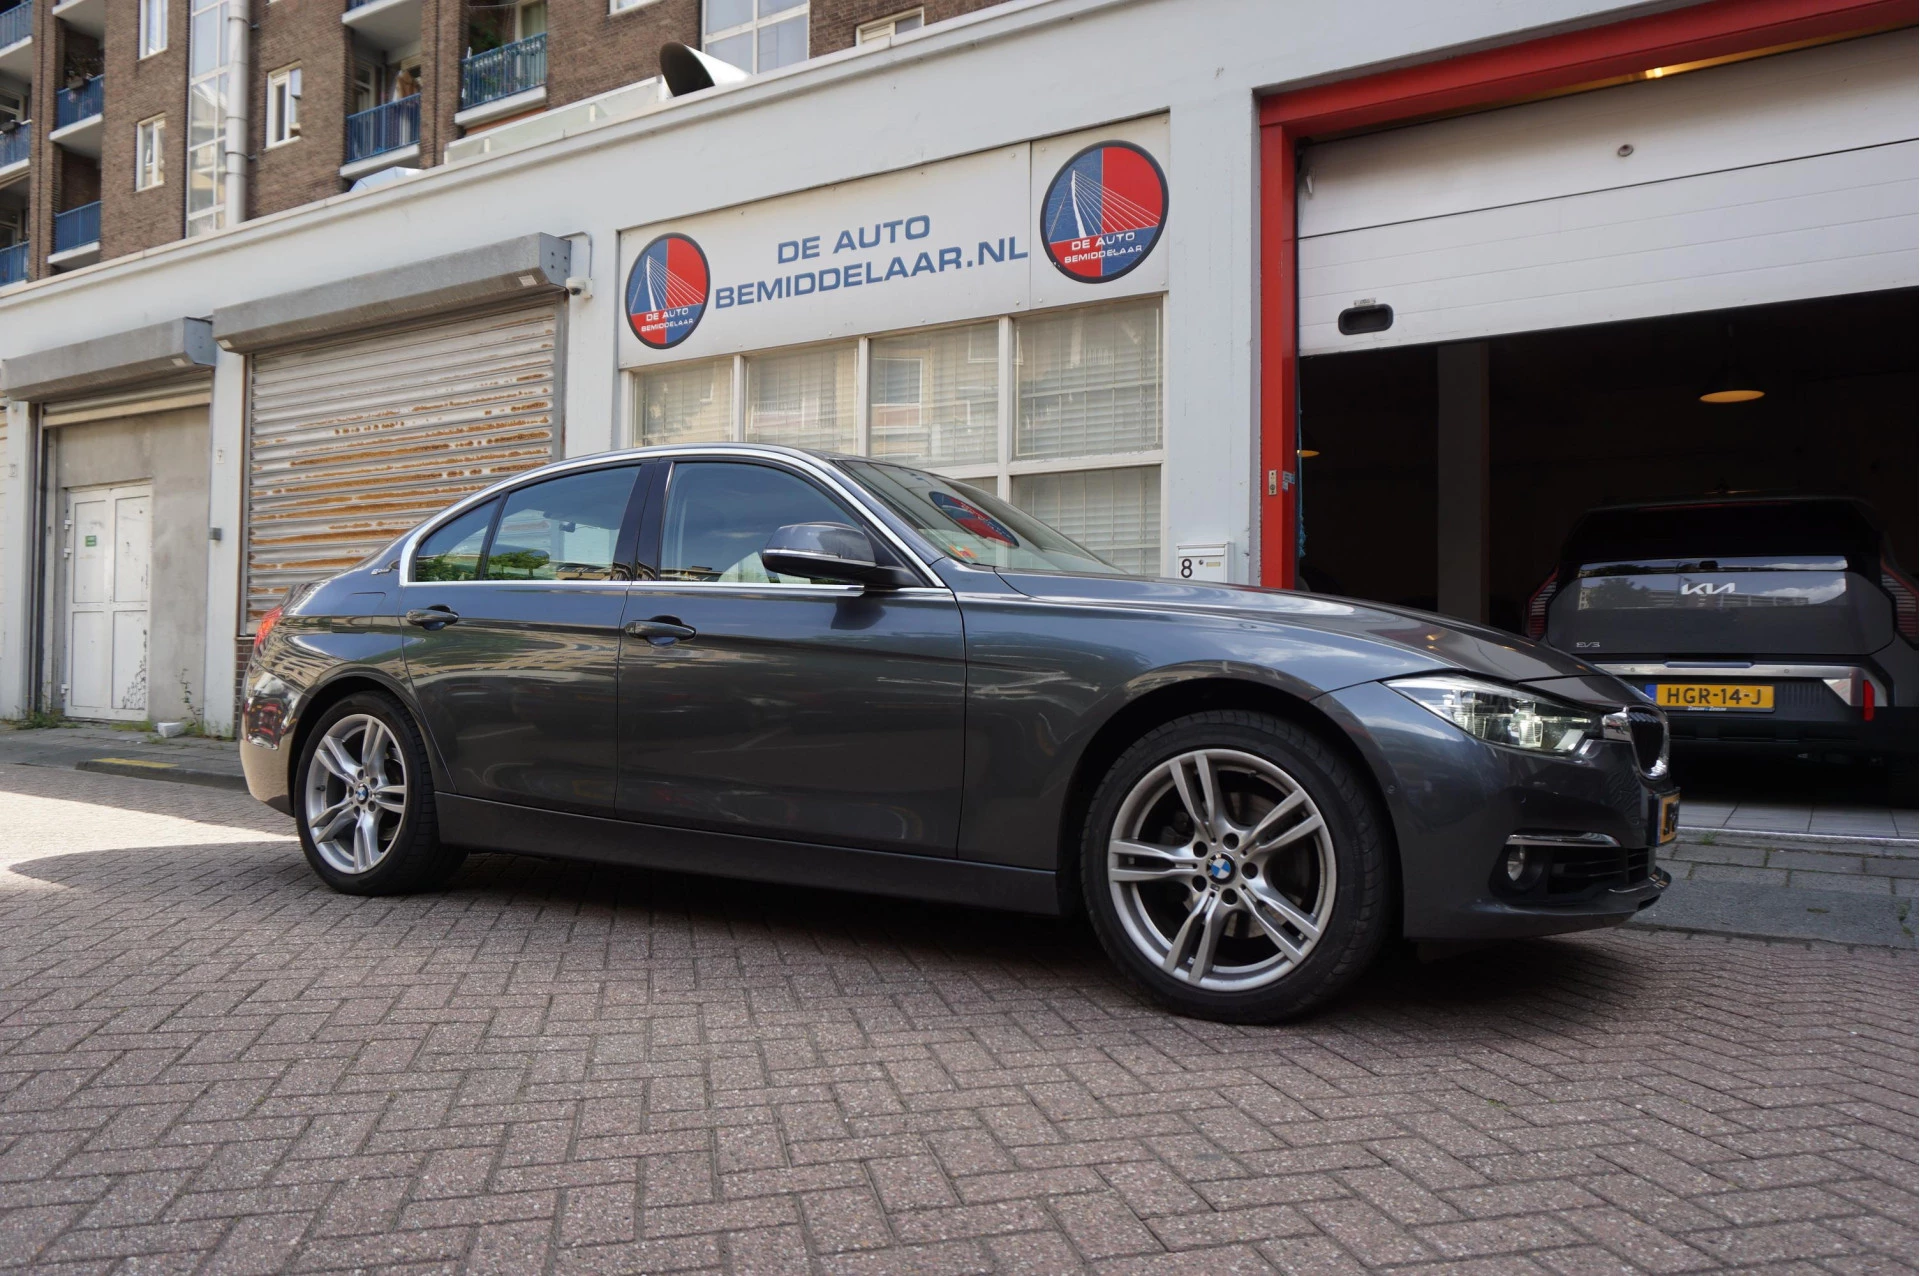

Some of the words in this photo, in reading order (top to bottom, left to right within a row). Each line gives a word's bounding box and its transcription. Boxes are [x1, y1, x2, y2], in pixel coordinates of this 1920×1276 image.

[777, 235, 821, 265] DE
[833, 214, 931, 254] AUTO
[1071, 239, 1091, 251] DE
[1095, 232, 1136, 247] AUTO
[1064, 244, 1143, 264] BEMIDDELAAR
[715, 236, 1029, 310] BEMIDDELAAR.NL
[645, 312, 660, 322] DE
[662, 307, 689, 319] AUTO
[641, 318, 694, 332] BEMIDDELAAR
[1180, 558, 1193, 579] 8
[1681, 582, 1736, 595] KIA
[1667, 687, 1762, 705] HGR-14-J
